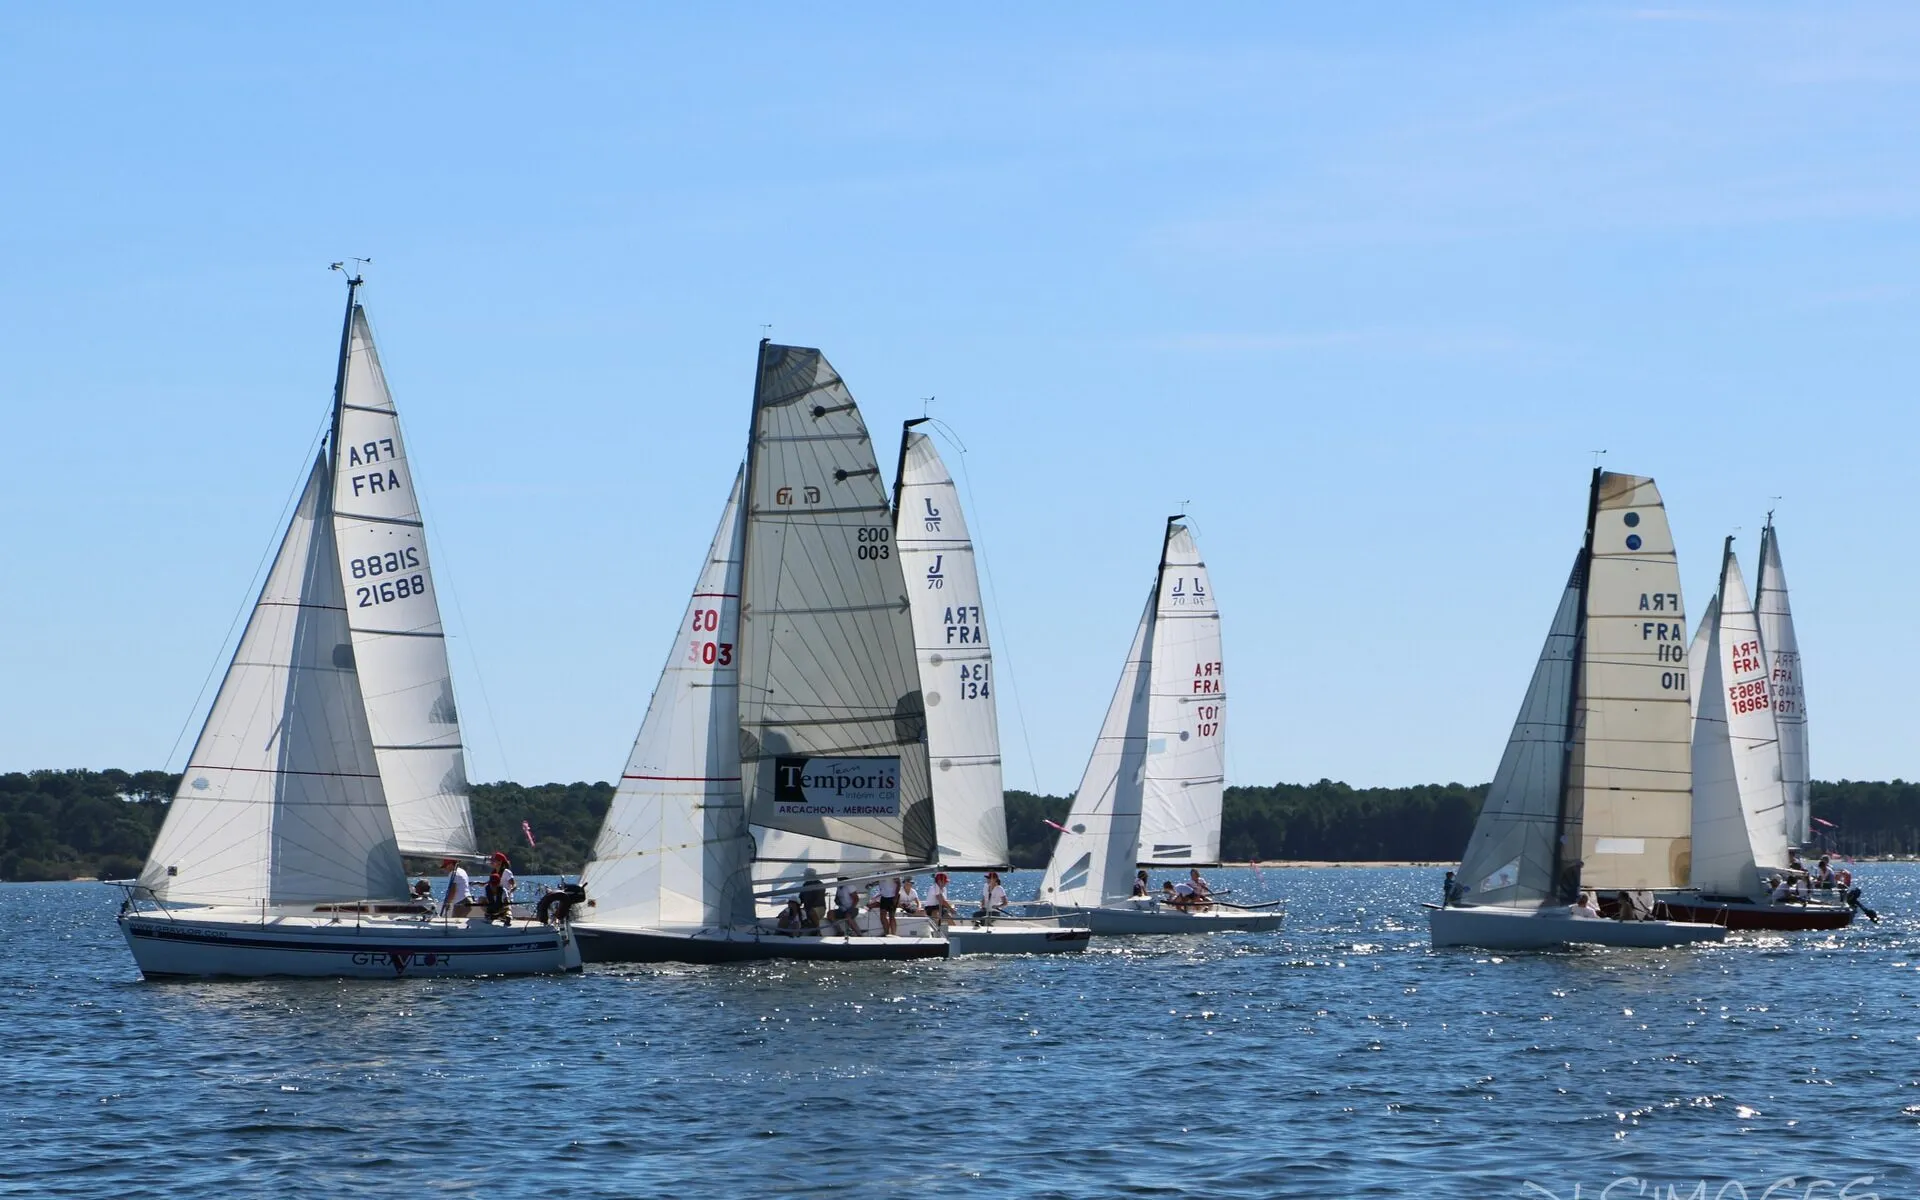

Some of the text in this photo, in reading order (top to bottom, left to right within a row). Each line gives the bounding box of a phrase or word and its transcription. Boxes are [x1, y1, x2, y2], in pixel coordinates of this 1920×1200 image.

[352, 469, 400, 497] FRA
[857, 545, 889, 560] 003
[356, 574, 425, 608] 21688
[927, 578, 944, 590] 70
[946, 626, 982, 644] FRA
[1643, 623, 1681, 641] FRA
[1733, 658, 1760, 675] FRA
[1661, 672, 1686, 690] 011
[1772, 669, 1793, 682] FRA
[961, 682, 990, 700] 134
[1193, 680, 1220, 694] FRA
[1732, 695, 1769, 715] 18963
[1197, 722, 1218, 737] 107
[827, 763, 860, 775] Team
[779, 806, 834, 814] ARCACHON
[844, 805, 893, 814] MERIGNAC
